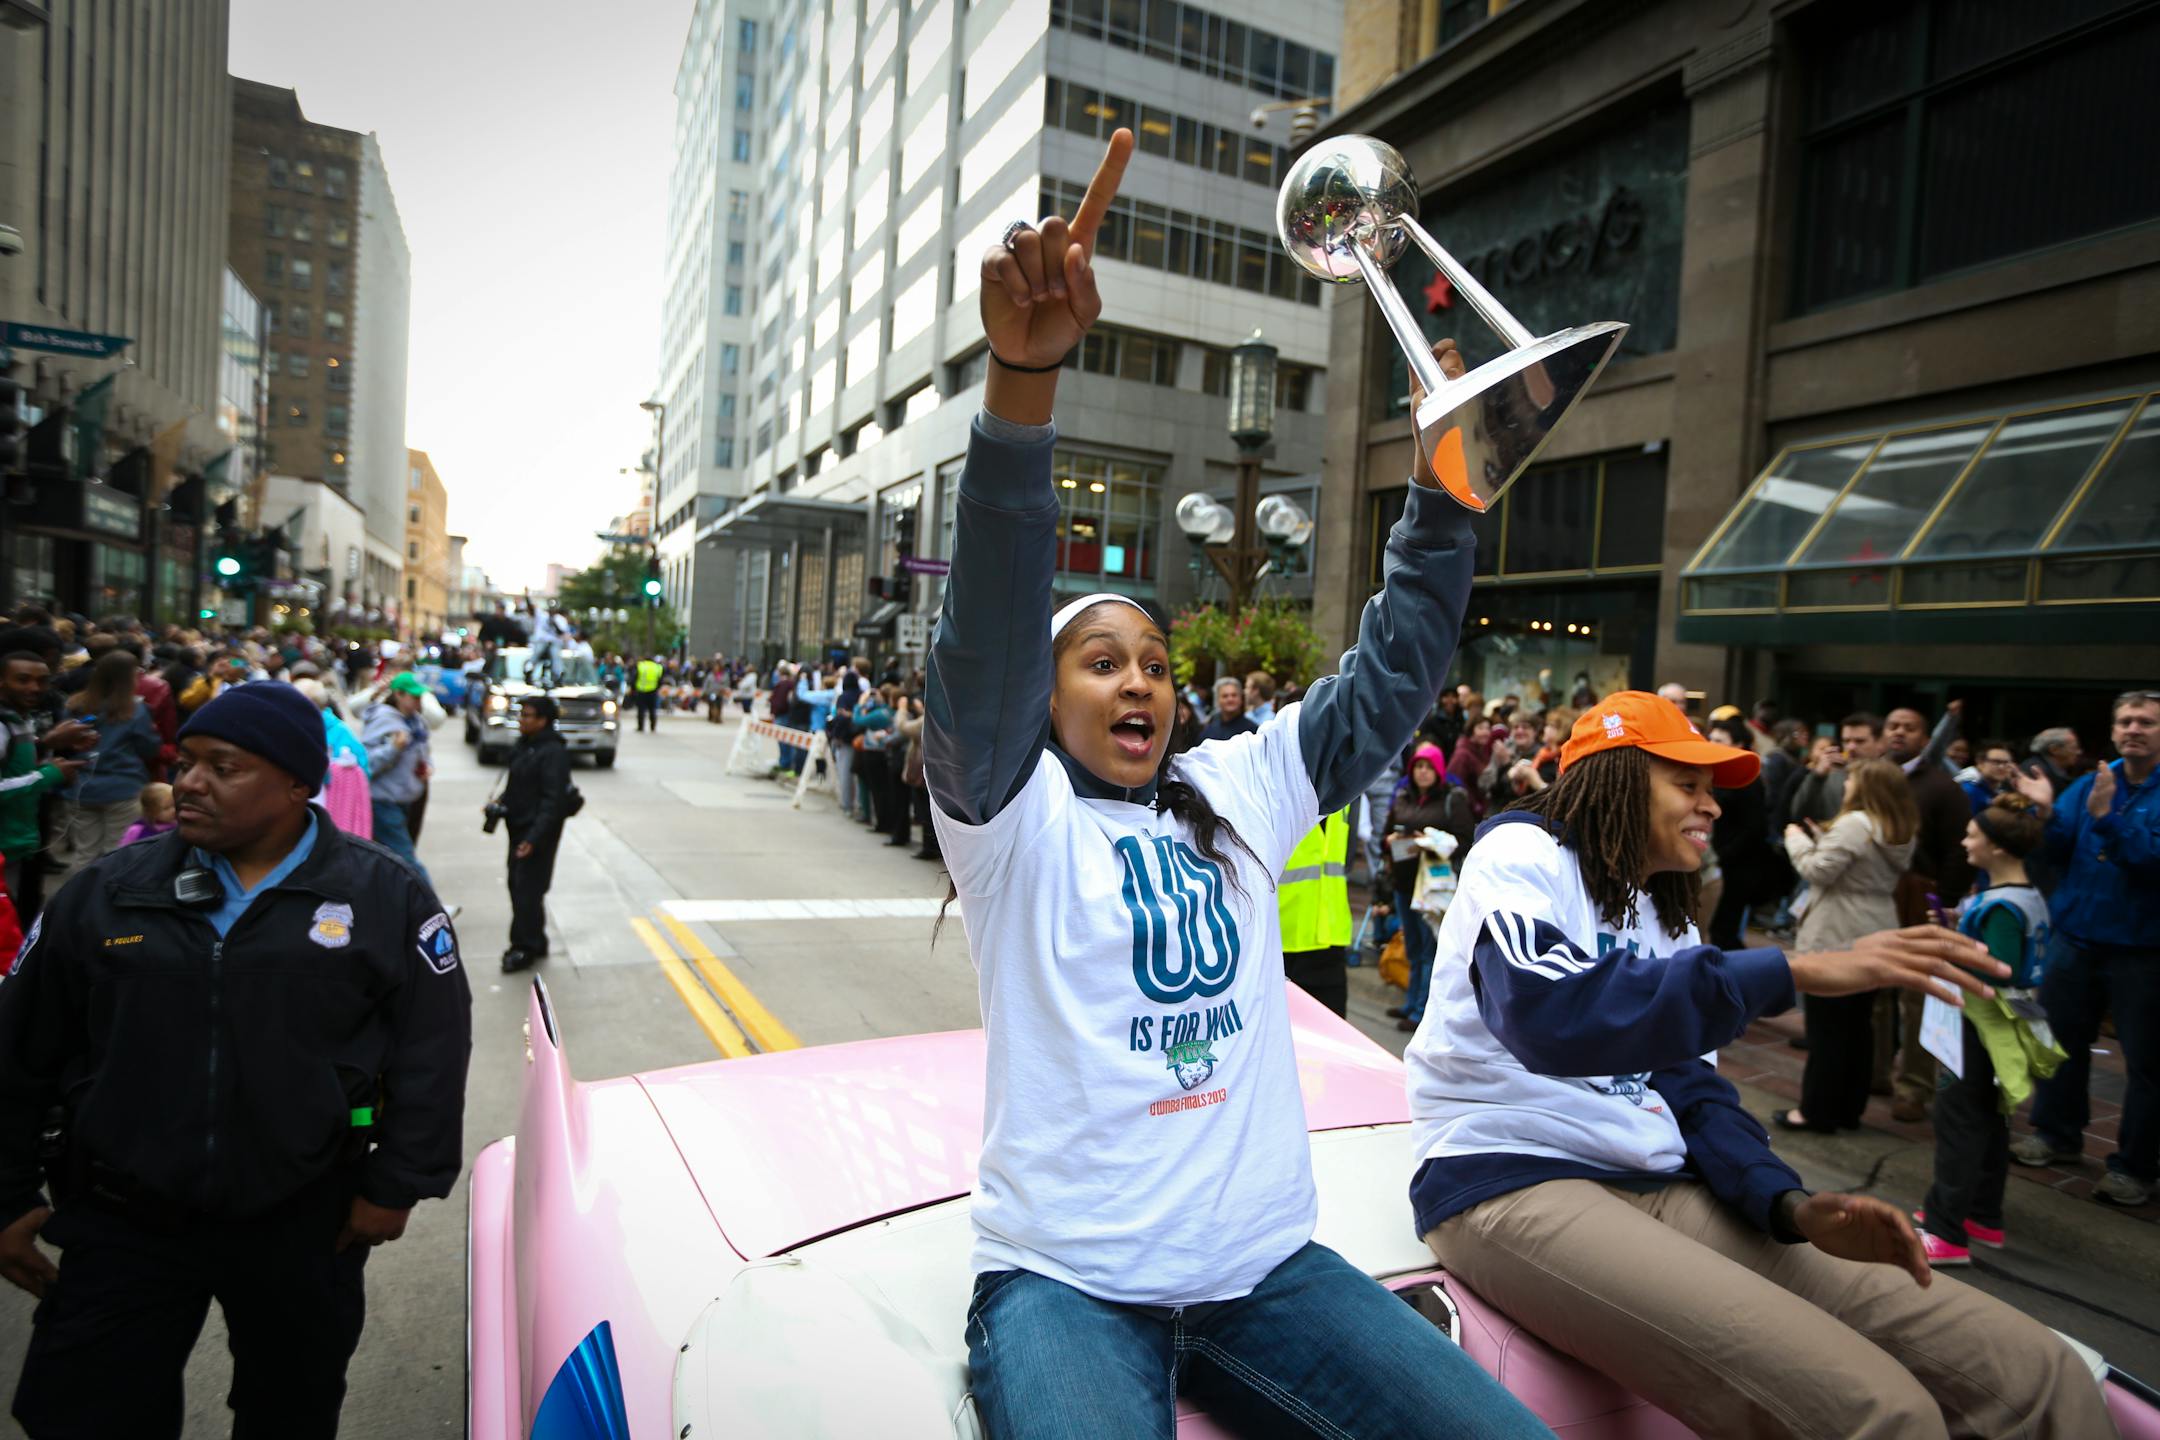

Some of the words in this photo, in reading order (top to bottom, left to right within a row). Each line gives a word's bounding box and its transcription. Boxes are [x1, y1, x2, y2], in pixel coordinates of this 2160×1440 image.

[48, 335, 92, 349] Street
[1606, 727, 1625, 739] 2013
[1130, 1015, 1154, 1051] IS
[1160, 1011, 1200, 1051] FOR
[1205, 998, 1243, 1041] WIN
[1181, 1093, 1207, 1111] FINALS
[1207, 1088, 1227, 1105] 2013
